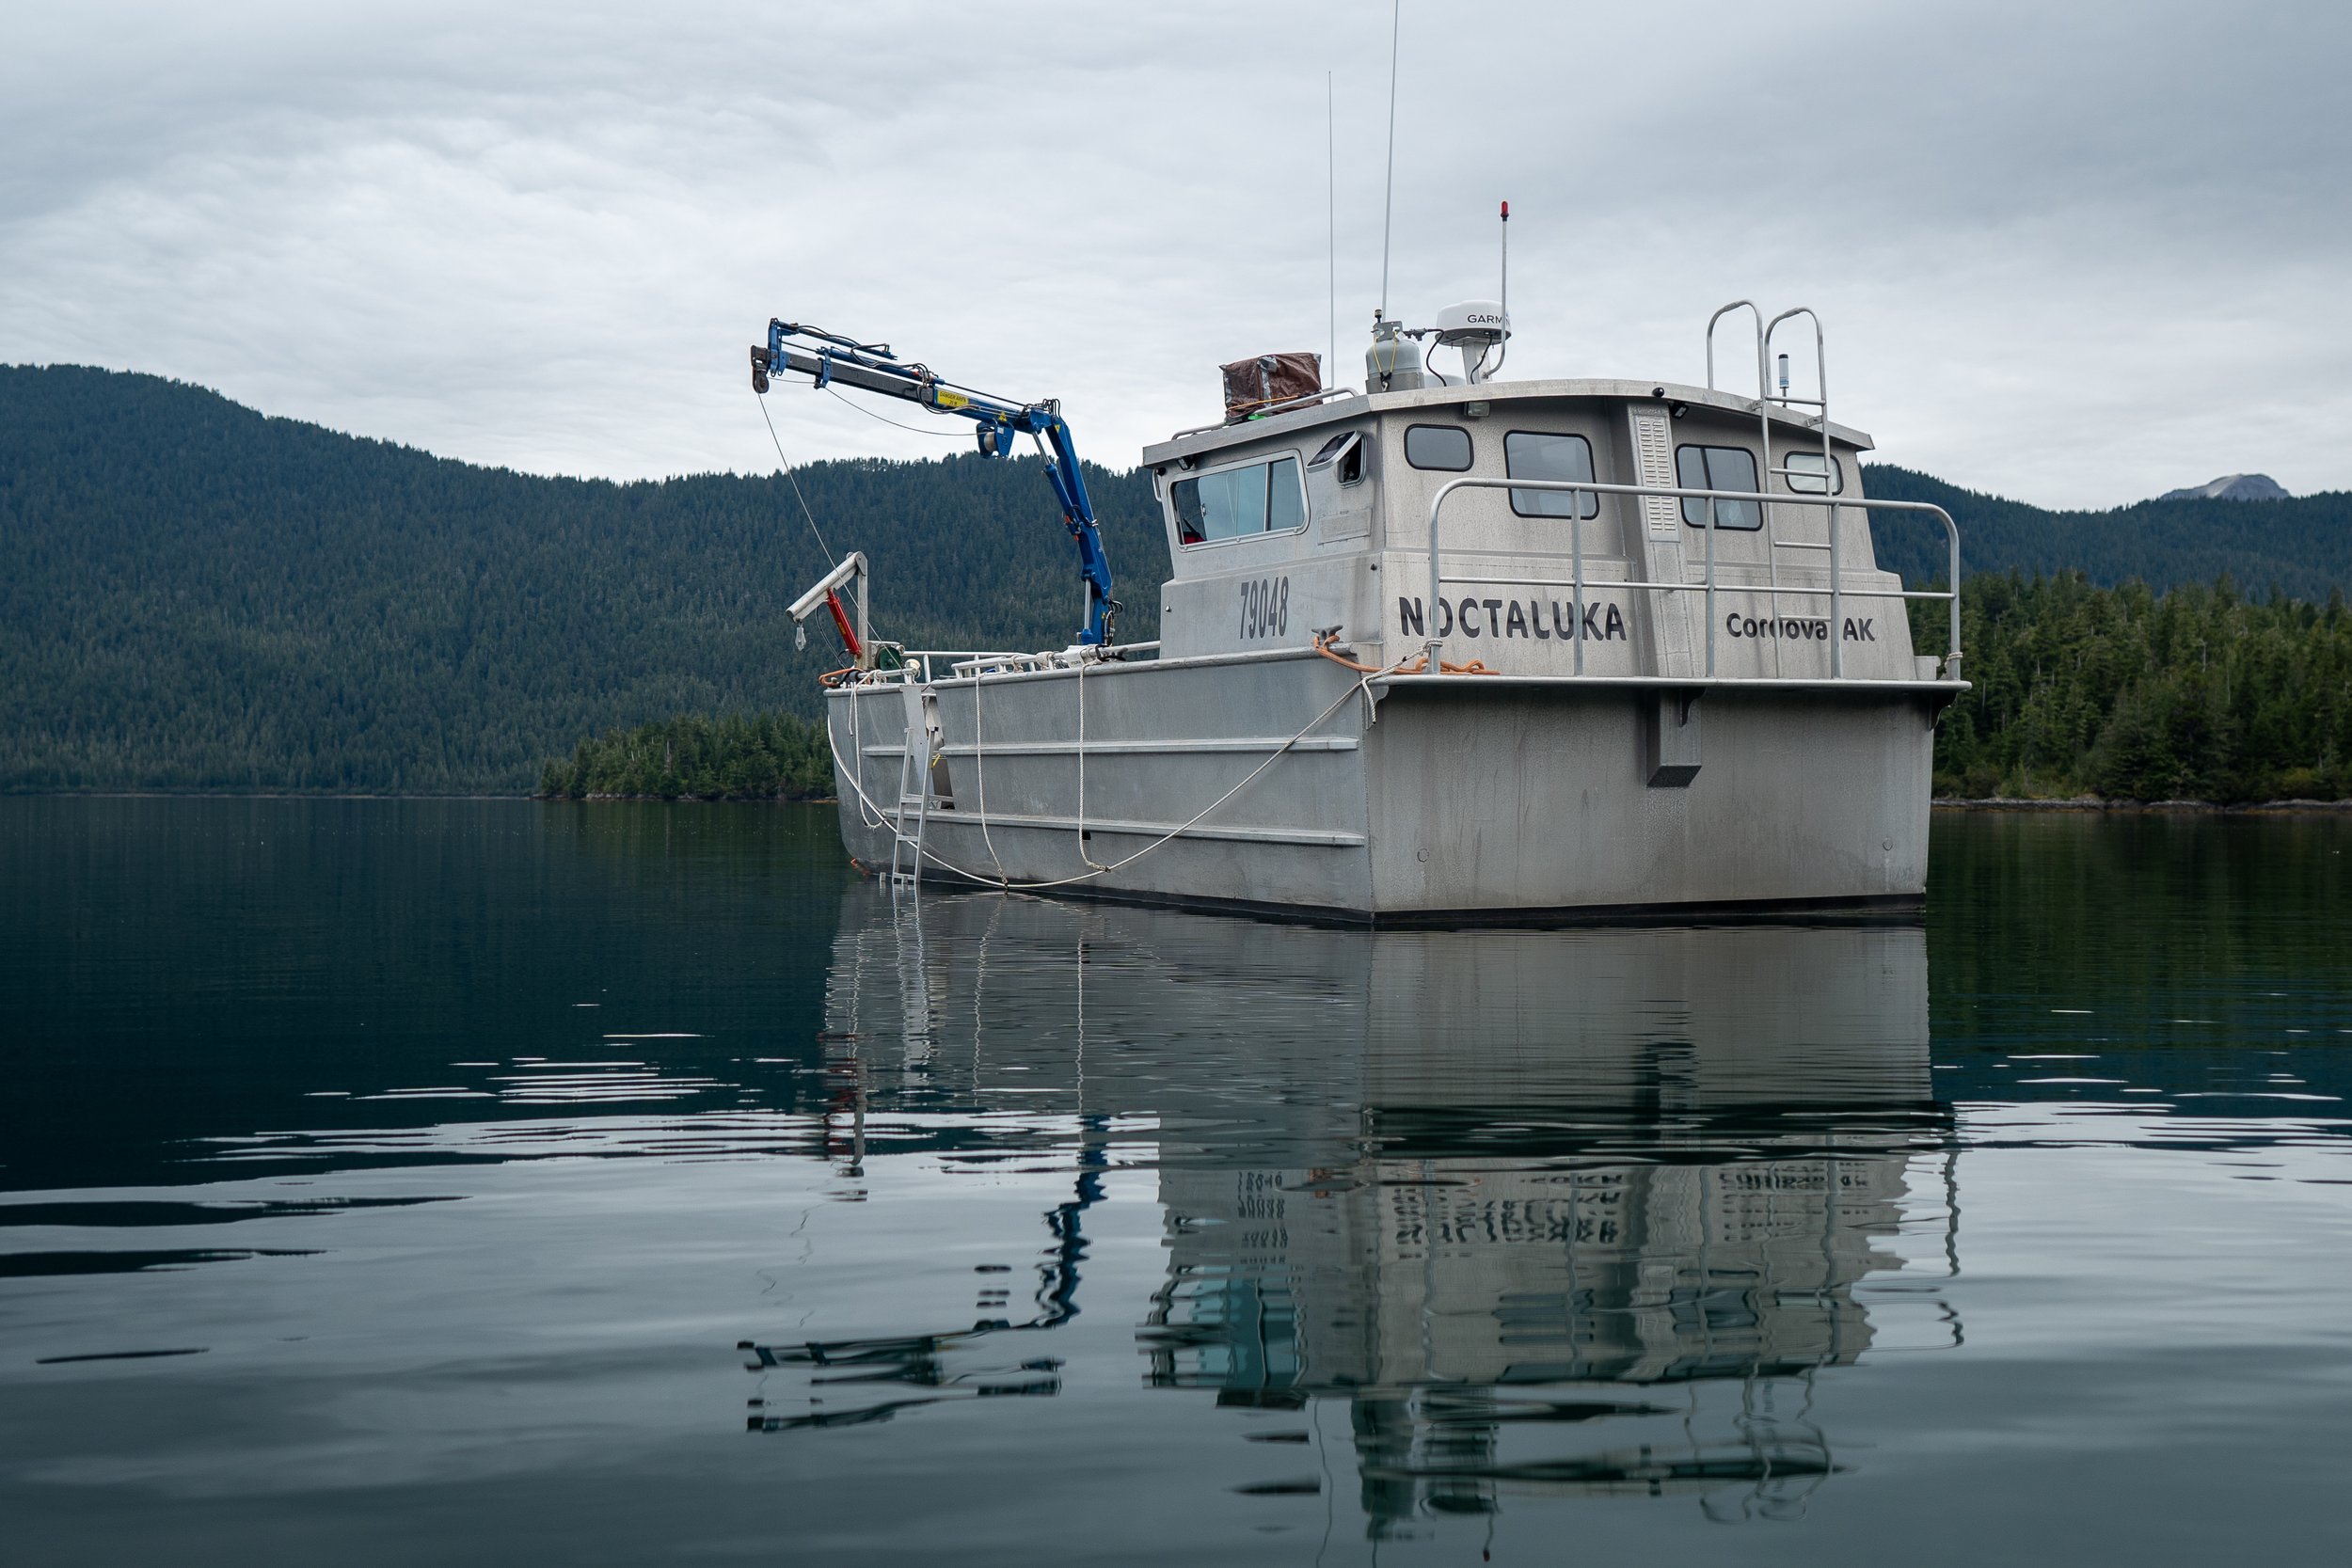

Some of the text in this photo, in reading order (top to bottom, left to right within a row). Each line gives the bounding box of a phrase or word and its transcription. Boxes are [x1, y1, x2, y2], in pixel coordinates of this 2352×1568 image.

[1468, 314, 1510, 326] GARMN
[1240, 576, 1289, 640] 79048
[1399, 596, 1627, 641] NOCTALUKA
[1842, 618, 1875, 641] AK
